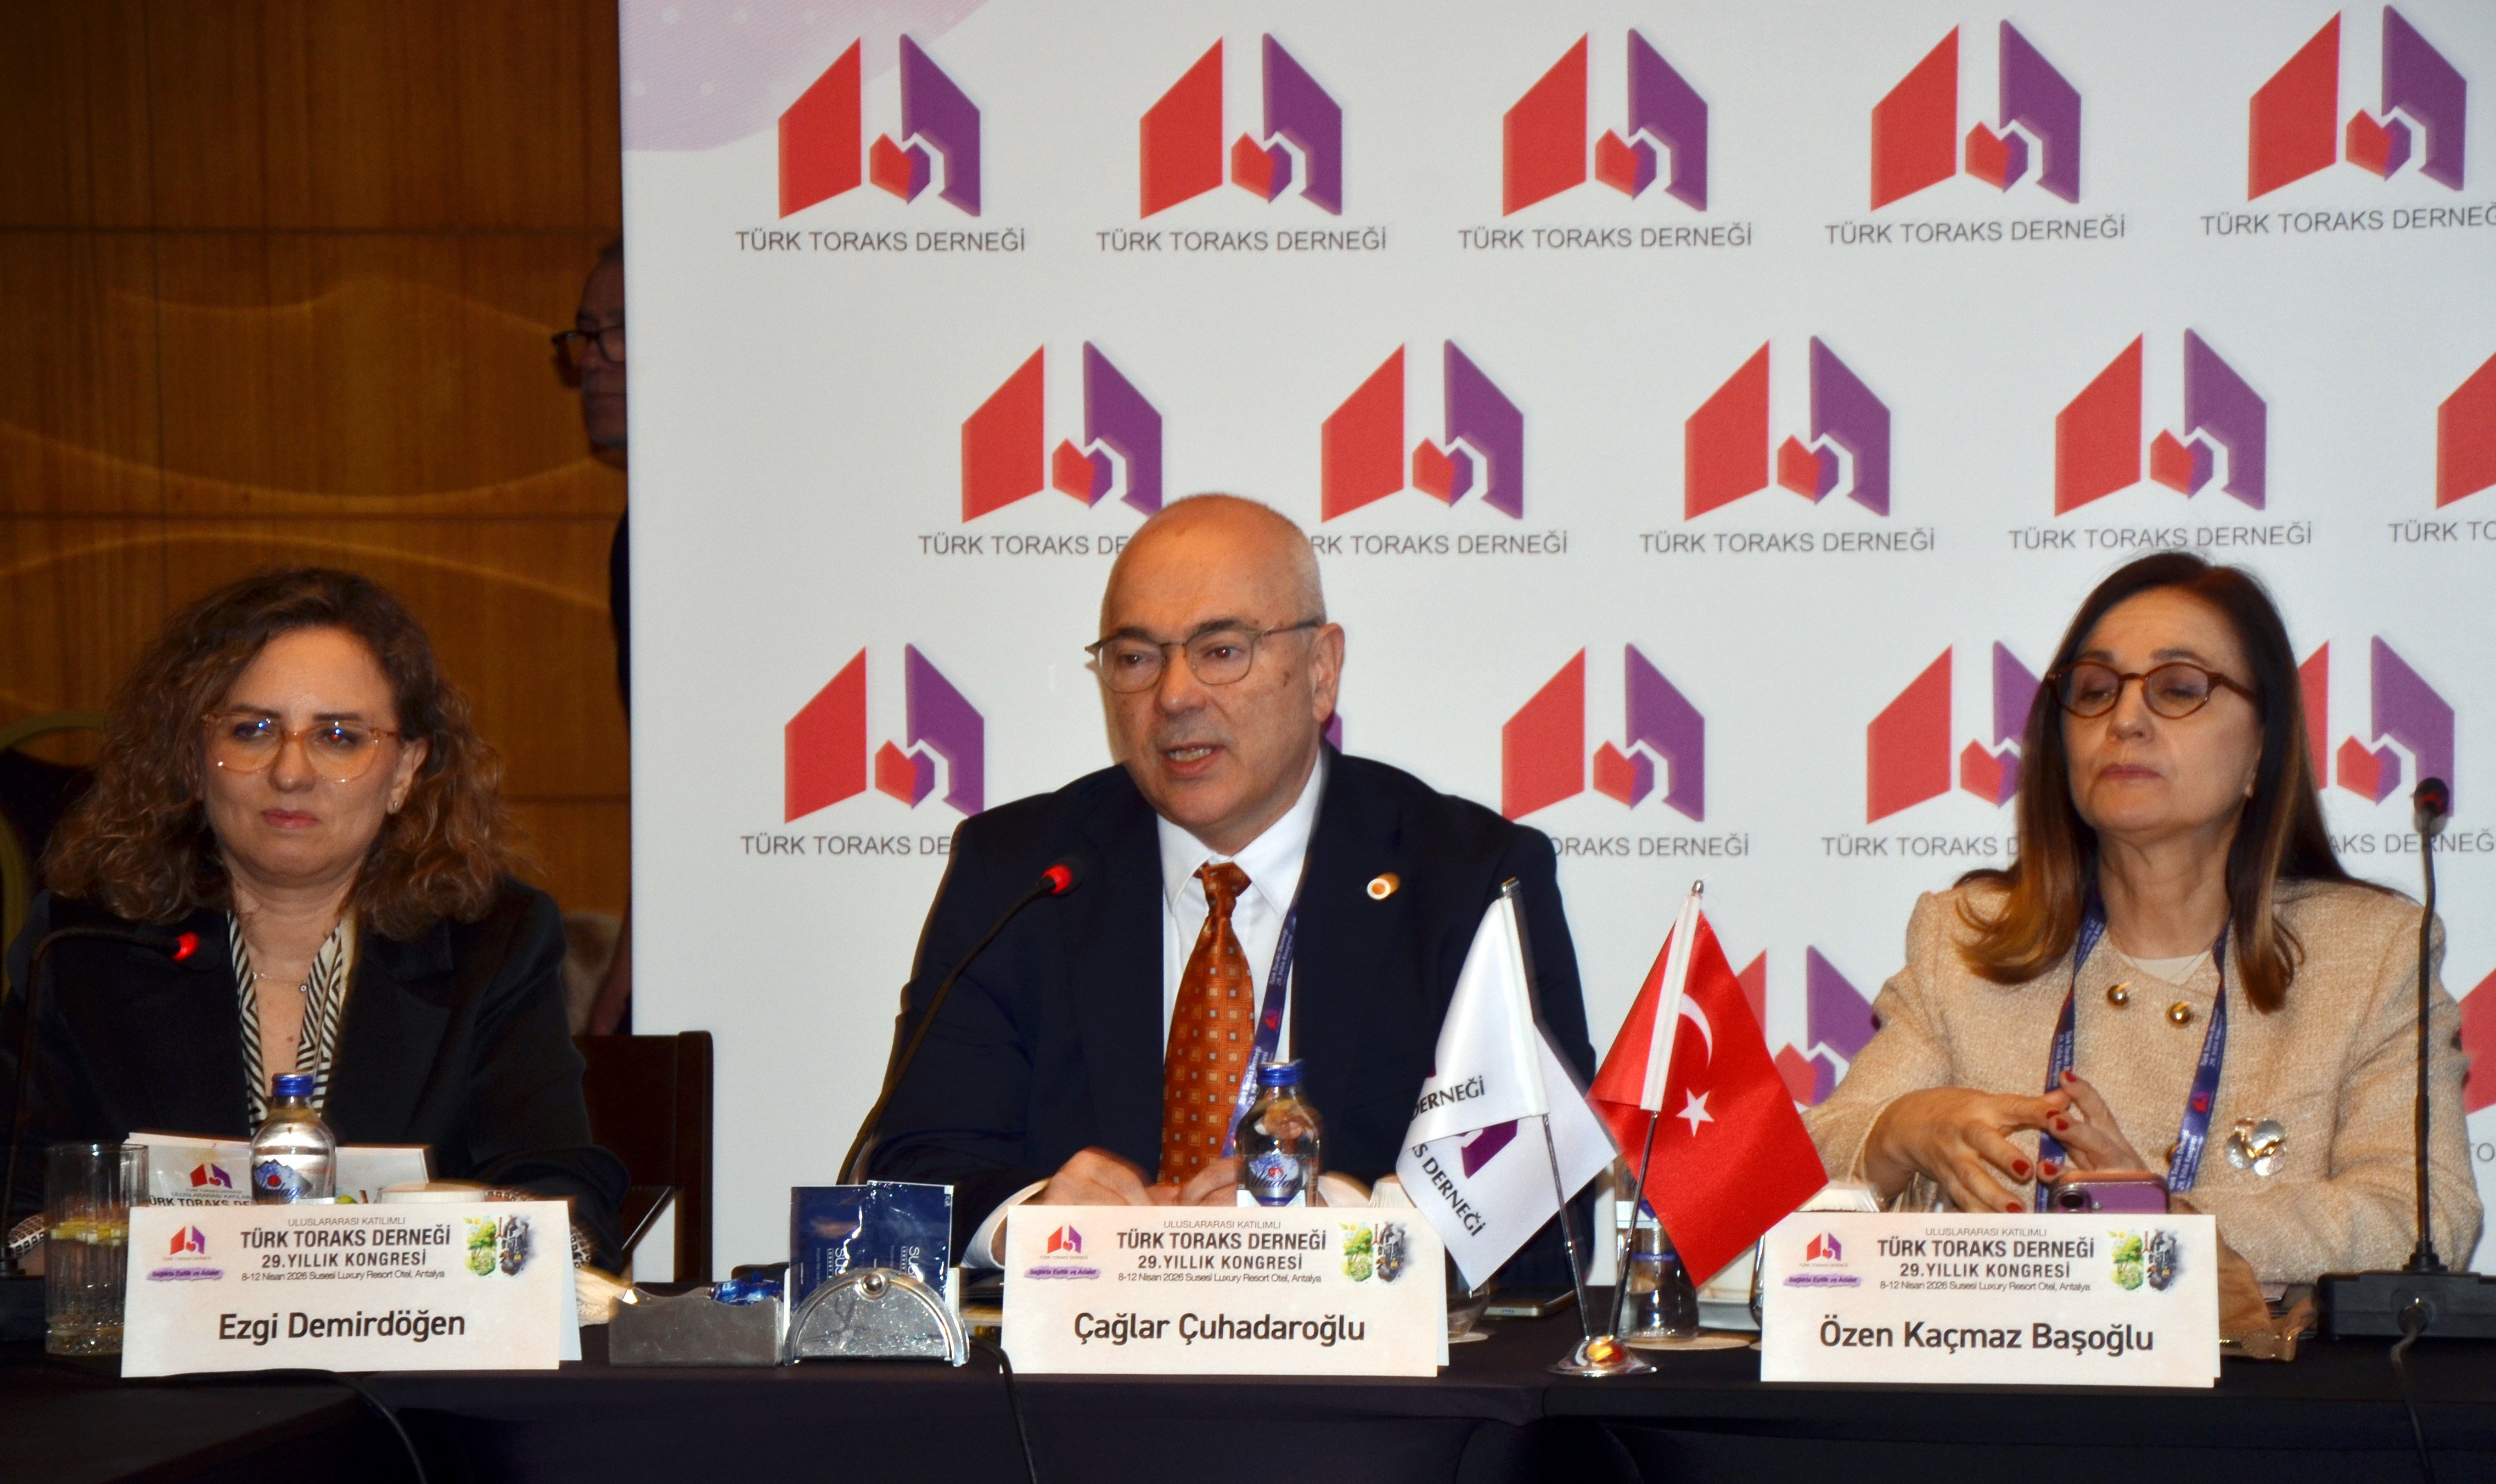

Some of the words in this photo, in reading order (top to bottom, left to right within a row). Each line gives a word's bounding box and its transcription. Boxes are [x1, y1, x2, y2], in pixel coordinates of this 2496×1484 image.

[1825, 221, 1892, 244] TÜRK
[1900, 221, 2003, 243] TORAKS
[2011, 214, 2125, 240] DERNEĞİ
[2201, 211, 2269, 235] TÜRK
[2278, 209, 2384, 233] TORAKS
[2393, 203, 2496, 229] DERNEĞ
[735, 228, 801, 251] TÜRK
[808, 231, 908, 251] TORAKS
[916, 227, 1025, 252] DERNEĞİ
[1096, 228, 1162, 252] TÜRK
[1169, 231, 1269, 251] TORAKS
[1277, 226, 1386, 251] DERNEĞİ
[1458, 226, 1524, 250] TÜRK
[1532, 227, 1632, 249] TORAKS
[1641, 223, 1752, 248] DERNEĞİ
[1311, 535, 1342, 554] RK
[1350, 535, 1449, 554] TORAKS
[1458, 530, 1567, 554] DERNEĞİ
[1639, 530, 1706, 554] TÜRK
[1713, 532, 1814, 553] TORAKS
[1823, 527, 1935, 552] DERNEĞİ
[2009, 526, 2076, 549] TÜRK
[2084, 527, 2188, 549] TORAKS
[2197, 520, 2312, 547] DERNEĞİ
[2388, 519, 2458, 542] TÜRK
[918, 532, 983, 555] TÜRK
[991, 535, 1089, 555] TORAKS
[740, 832, 805, 855] TÜRK
[812, 835, 911, 855] TORAKS
[1551, 837, 1631, 856] ORAKS
[1639, 833, 1749, 857] DERNEĞİ
[1821, 834, 1888, 857] TÜRK
[1896, 836, 1998, 857] TORAKS
[2385, 828, 2494, 853] DENEĞ
[149, 1195, 175, 1206] ÜRK
[177, 1198, 229, 1206] TORAKS
[1423, 1157, 1486, 1236] DERNEĞİ
[288, 1217, 359, 1227] ULUSLARARASI
[362, 1216, 406, 1225] KATILIMLI
[1163, 1220, 1235, 1229] ULUSLARARASI
[1237, 1221, 1281, 1229] KATILIMLI
[1925, 1227, 1999, 1236] ULUSLARARASI
[2002, 1228, 2047, 1237] KATILIMLI
[240, 1227, 289, 1249] TÜRK
[293, 1229, 366, 1247] TORAKS
[372, 1223, 450, 1246] DERNEĞİ
[1116, 1228, 1165, 1249] TÜRK
[1169, 1232, 1242, 1249] TORAKS
[1248, 1229, 1326, 1250] DERNEĞİ
[1877, 1236, 1926, 1257] TÜRK
[1931, 1239, 2006, 1257] TORAKS
[2014, 1236, 2094, 1258] DERNEĞİ
[261, 1252, 339, 1268] 29.YILLIK
[345, 1248, 426, 1267] KONGRESİ
[1138, 1255, 1215, 1269] 29.YILLIK
[1221, 1254, 1302, 1270] KONGRESİ
[1900, 1263, 1979, 1277] 29.YILLIK
[1986, 1261, 2070, 1278] KONGRESİ
[219, 1312, 278, 1346] Ezgi
[288, 1308, 465, 1342] Demirdöğen
[1074, 1312, 1171, 1346] Çağlar
[1179, 1313, 1365, 1347] Çuhadaroğlu
[1820, 1314, 1893, 1347] Özen
[1904, 1321, 2022, 1354] Kaçmaz
[2032, 1323, 2153, 1357] Başoğlu
